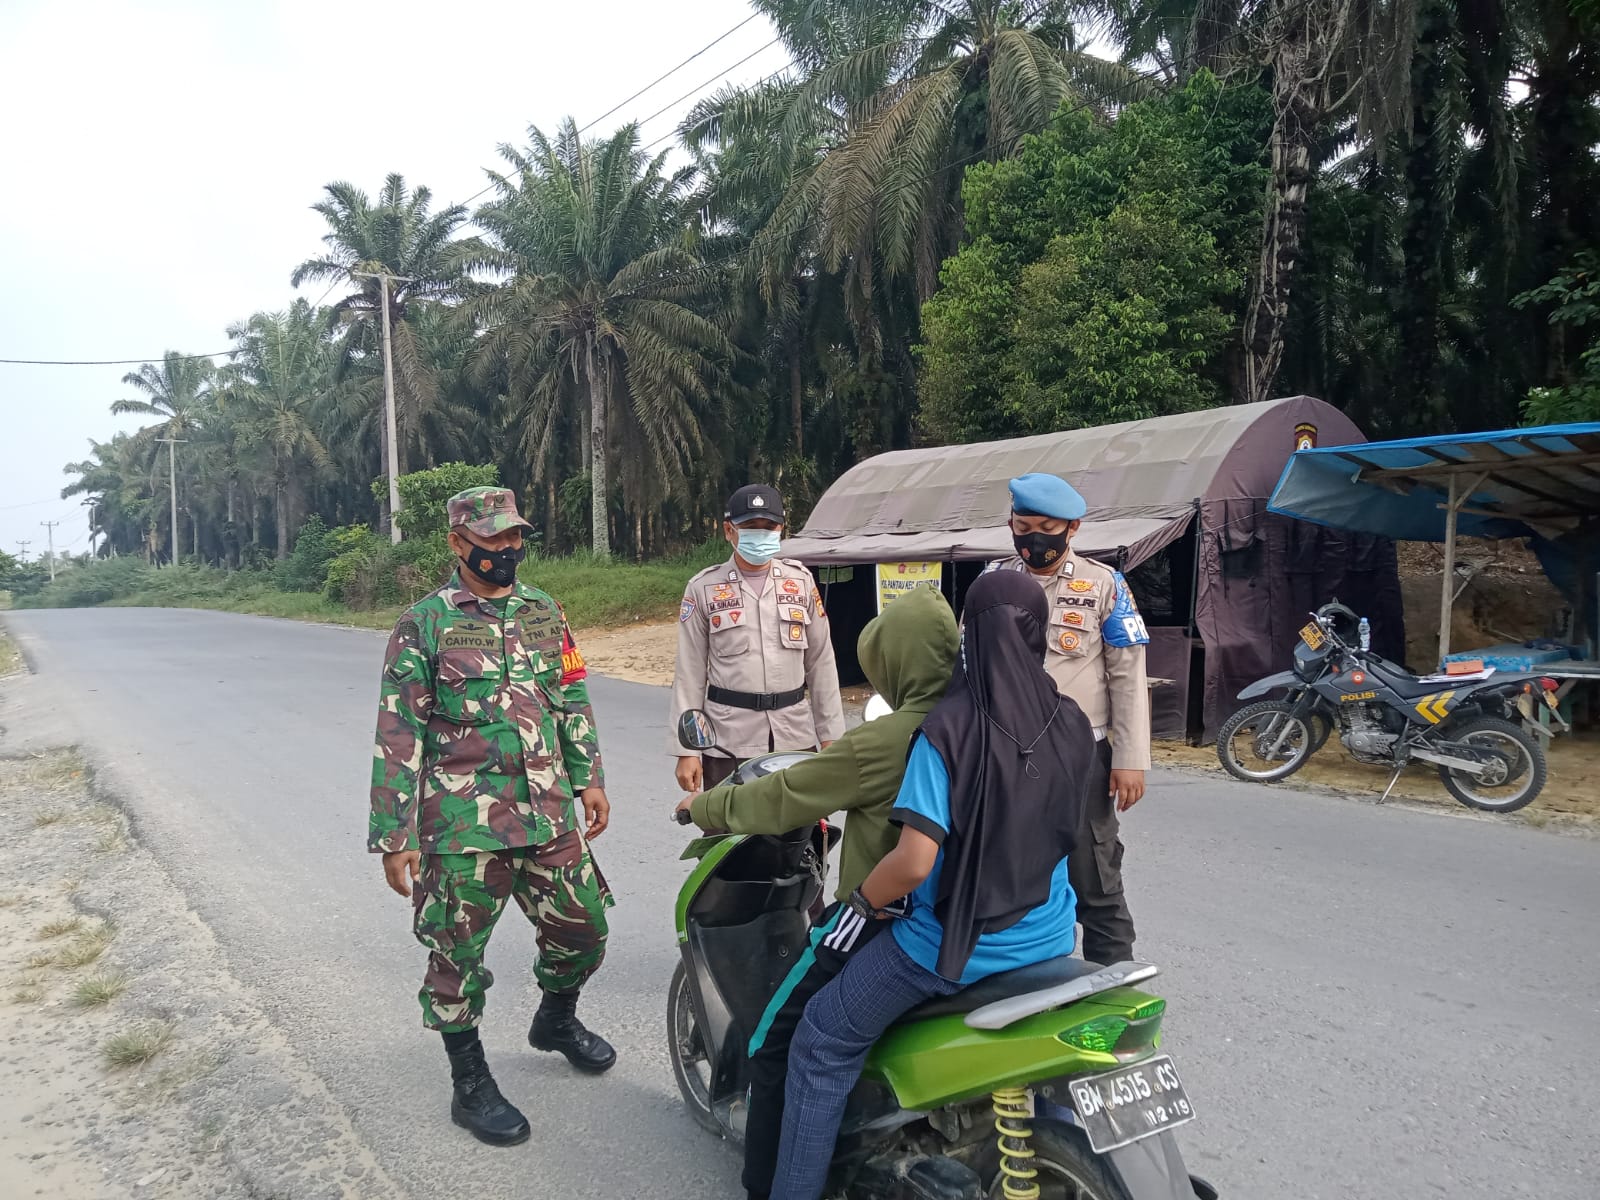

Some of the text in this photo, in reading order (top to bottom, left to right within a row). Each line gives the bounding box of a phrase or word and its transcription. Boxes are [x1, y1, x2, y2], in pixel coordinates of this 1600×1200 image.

[1057, 596, 1096, 607] POLRI
[526, 630, 545, 640] TNI
[445, 636, 495, 647] CAHYO.W
[1341, 691, 1376, 702] POLISI
[1110, 1071, 1152, 1107] 4515
[1155, 1063, 1179, 1091] CS
